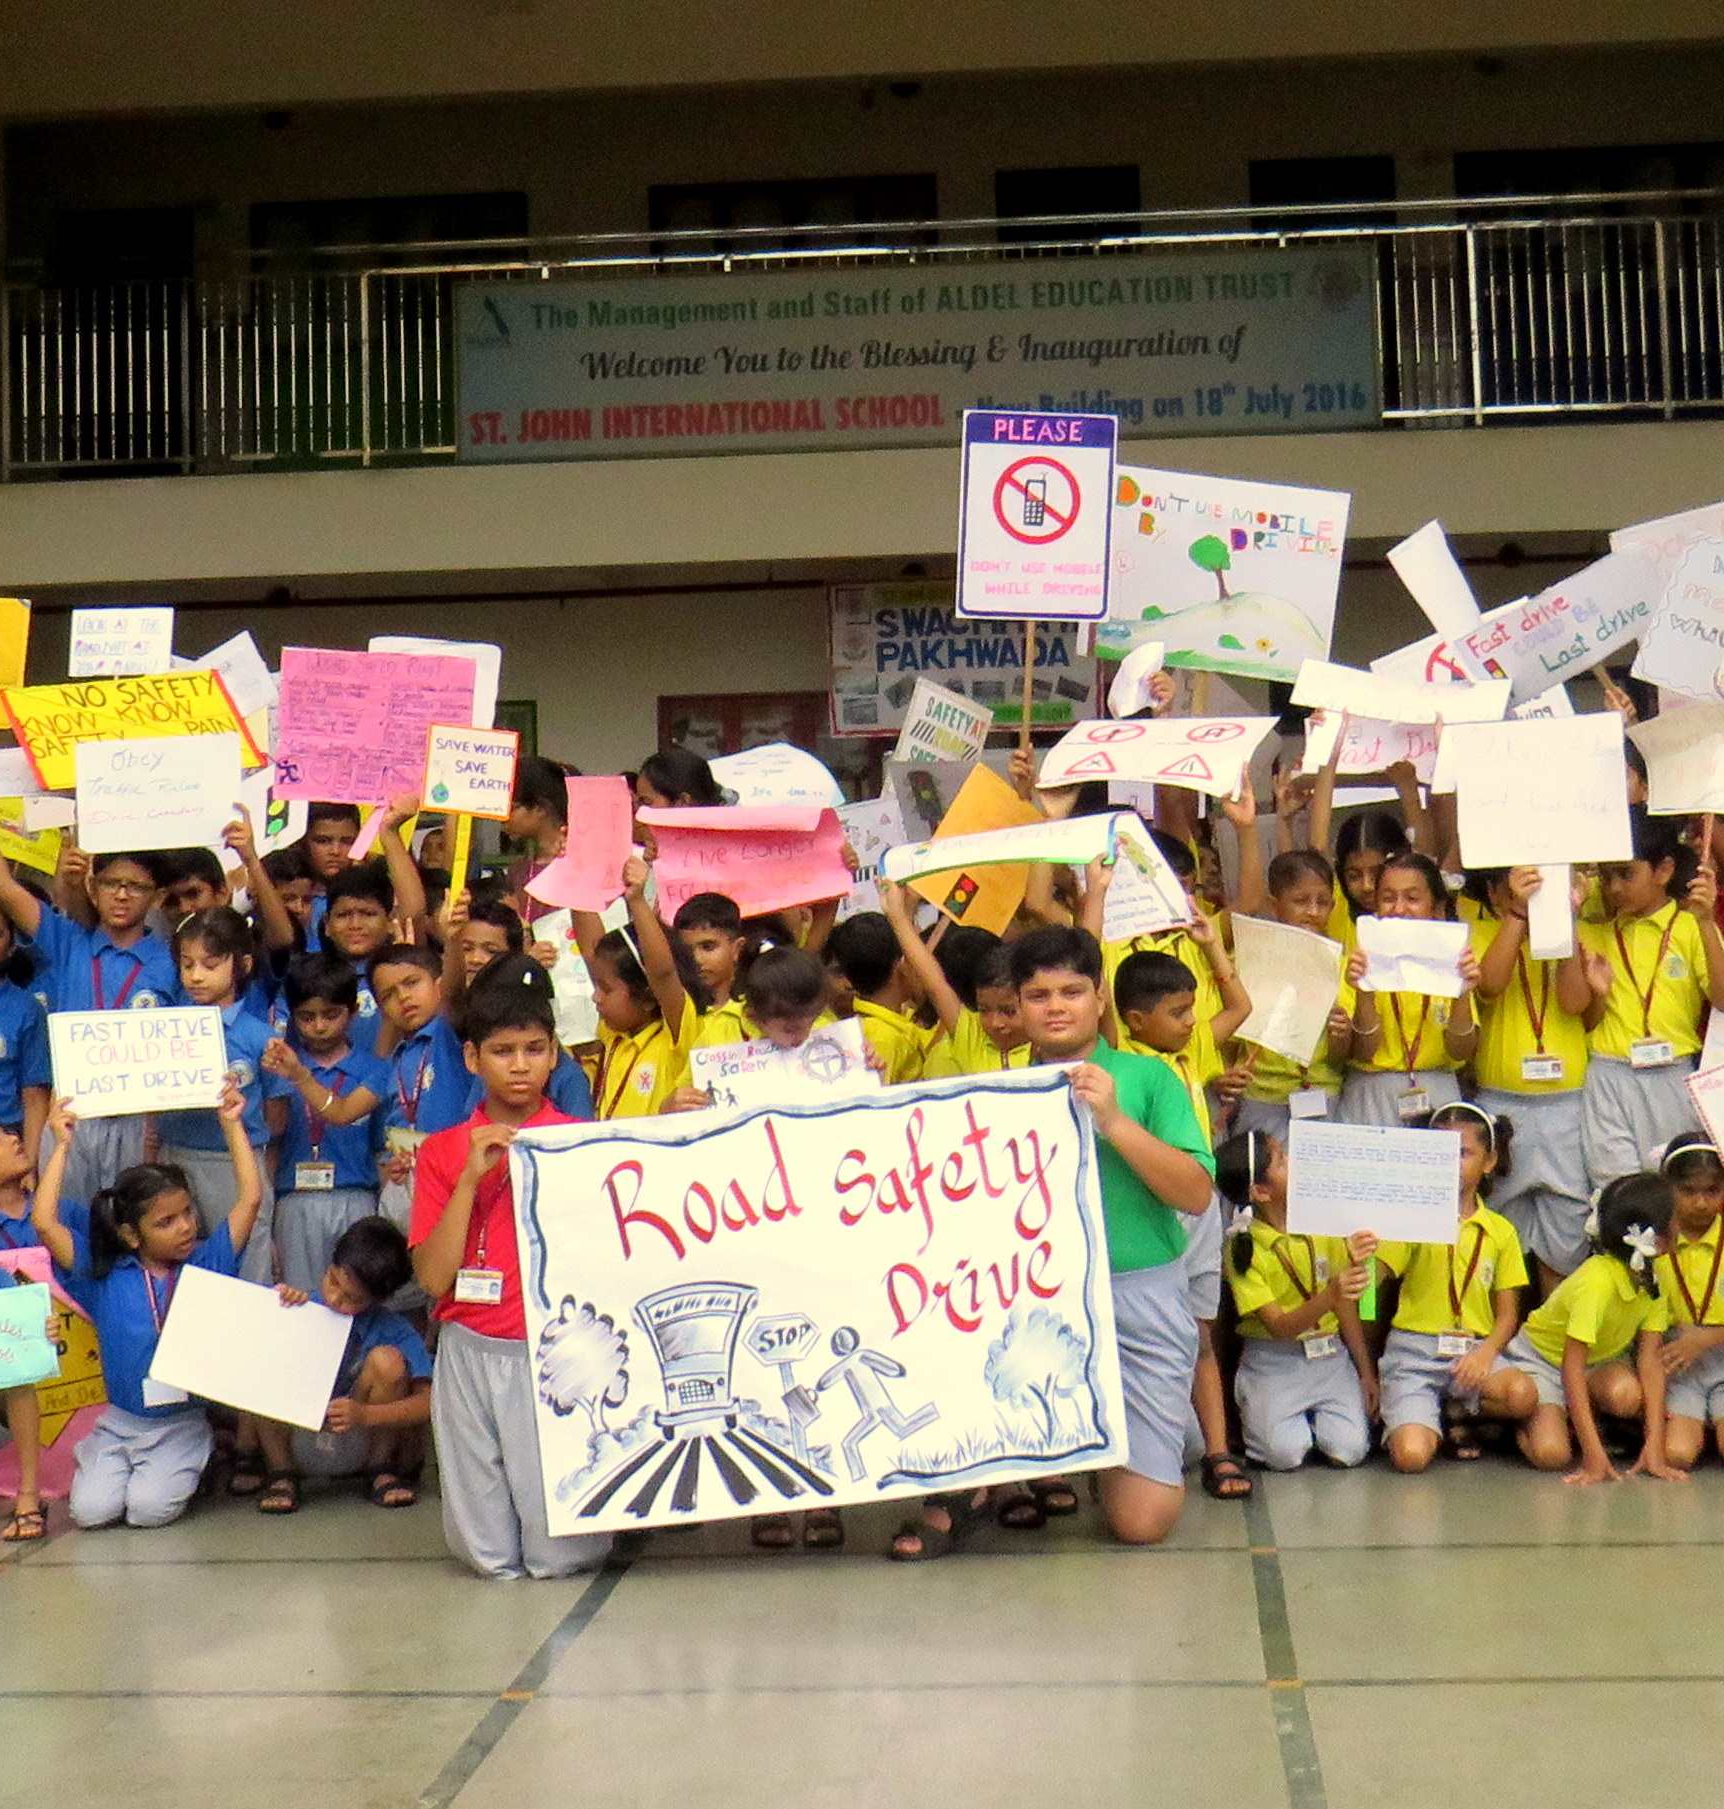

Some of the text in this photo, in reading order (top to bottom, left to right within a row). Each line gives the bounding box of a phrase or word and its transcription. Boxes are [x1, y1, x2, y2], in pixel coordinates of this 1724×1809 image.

[531, 271, 1295, 332] The Management and Staff of ALDEL EDUCATION TRUST
[579, 323, 1247, 381] Welcome You to the Blessing & Inauguration of
[468, 411, 507, 445] ST.
[516, 406, 592, 443] JOHN
[601, 399, 827, 439] INTERNATIONAL
[833, 393, 945, 431] SCHOOL
[1153, 397, 1185, 418] on
[1243, 384, 1295, 420] July
[1301, 381, 1368, 413] 2016
[993, 417, 1083, 442] PLEASE
[1231, 506, 1334, 542] MOBILE
[1020, 561, 1047, 574] USE
[984, 583, 1030, 596] WHILE
[1464, 595, 1571, 660] Fast drive
[1538, 631, 1593, 674] Last
[1595, 599, 1651, 643] drive
[59, 673, 218, 709] NO SAFETY
[21, 698, 194, 738] KNOW KNOW
[435, 738, 471, 754] SAVE
[454, 759, 491, 775] SAVE
[467, 777, 512, 793] EARTH
[69, 1015, 213, 1043] FAST DRIVE
[84, 1038, 204, 1066] COULD BE
[74, 1072, 130, 1096] LAST
[142, 1067, 215, 1089] DRIVE
[601, 1116, 805, 1262] Road
[832, 1098, 1059, 1257] Safety
[883, 1239, 1066, 1340] Drive
[758, 1322, 812, 1355] STOP
